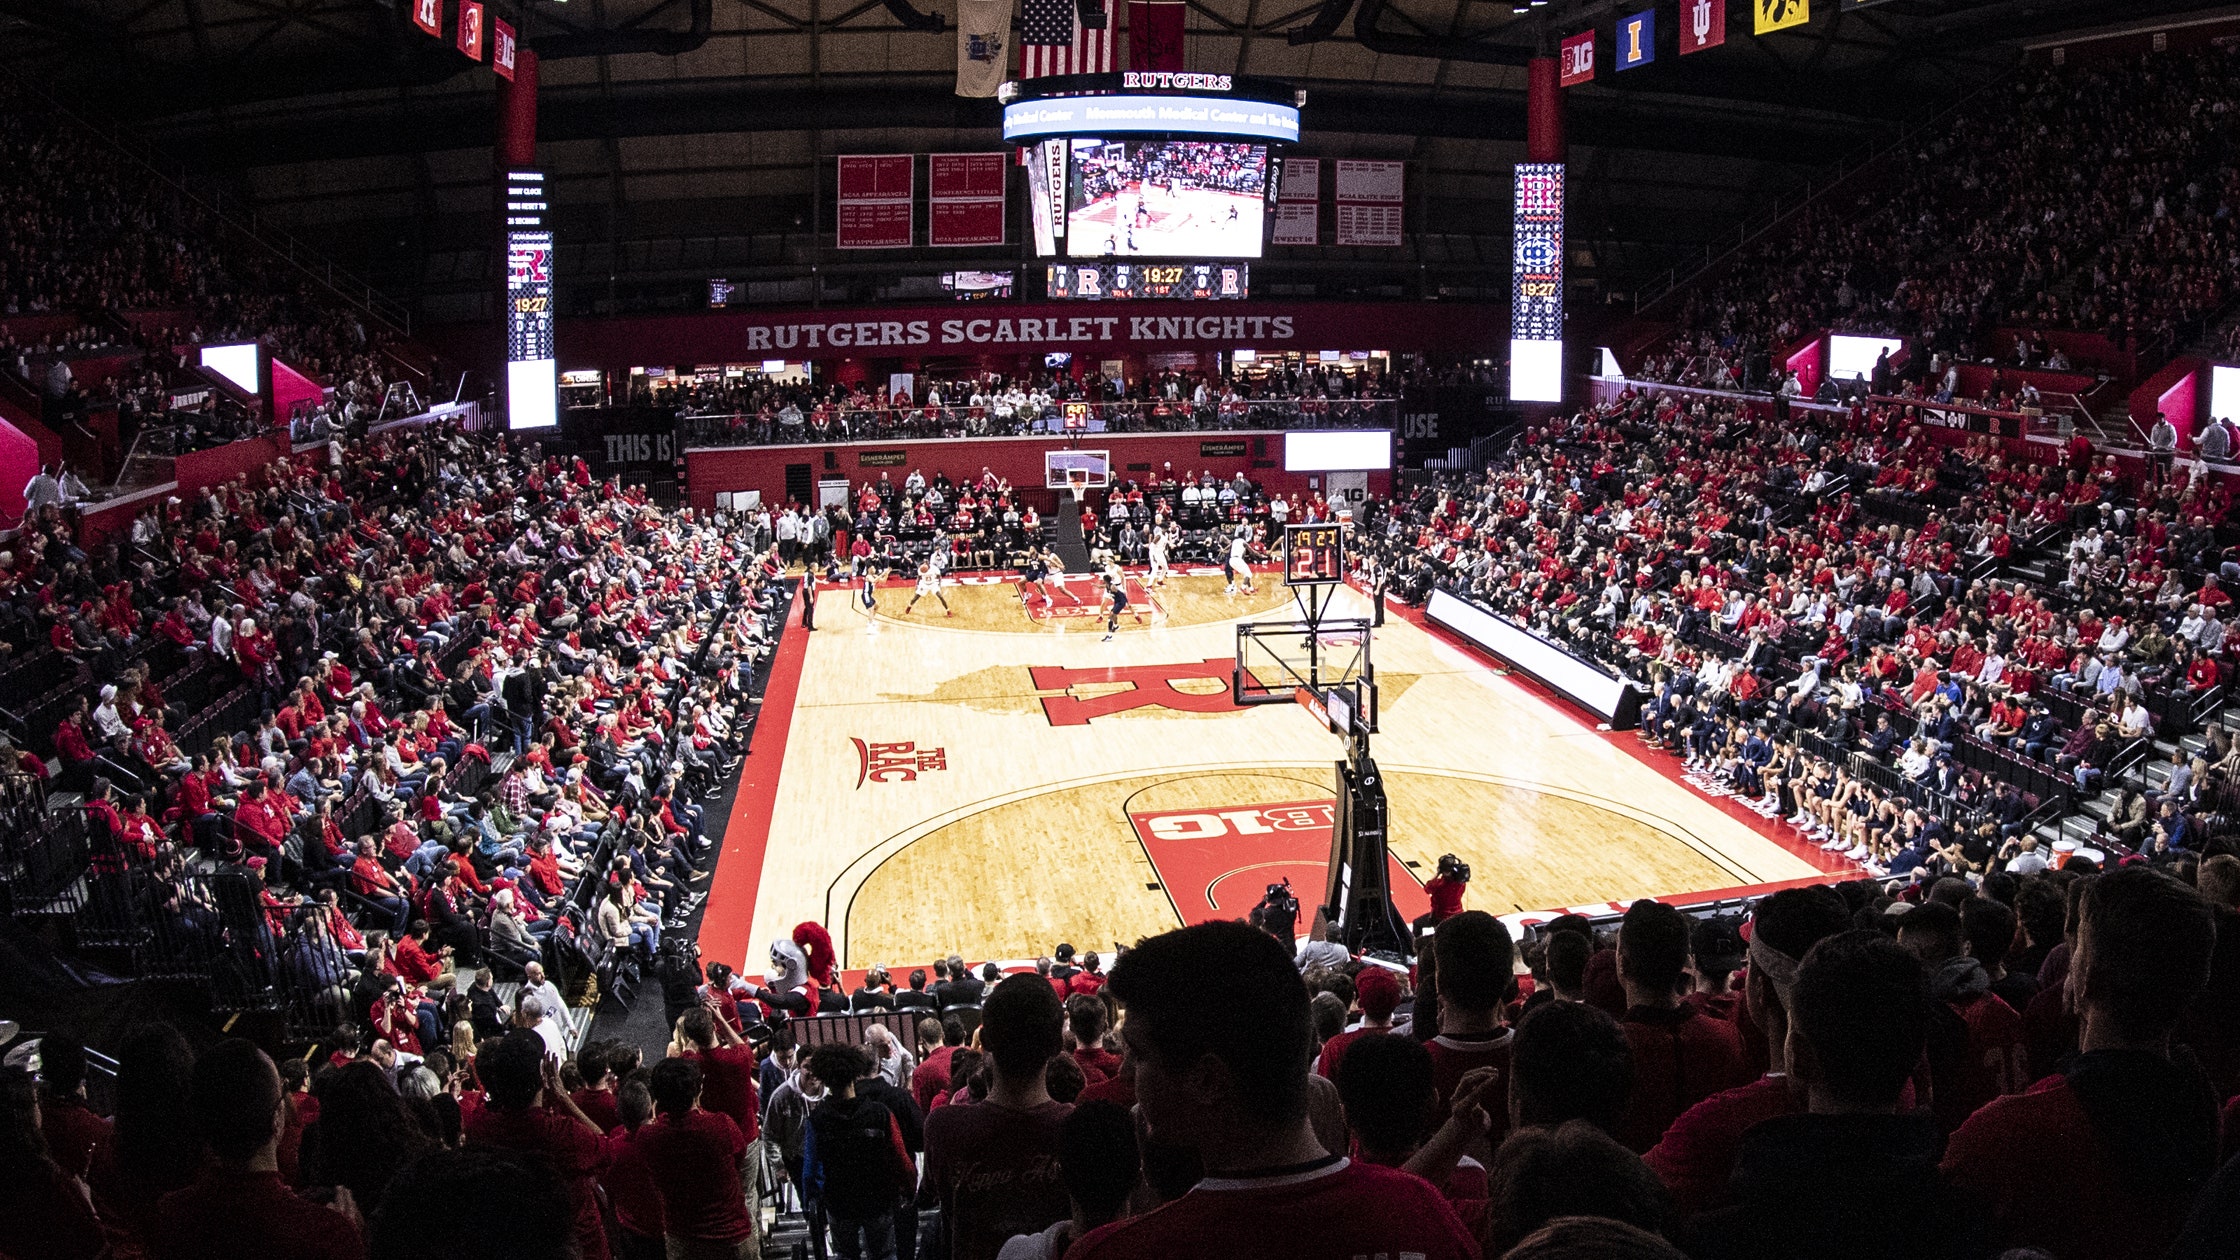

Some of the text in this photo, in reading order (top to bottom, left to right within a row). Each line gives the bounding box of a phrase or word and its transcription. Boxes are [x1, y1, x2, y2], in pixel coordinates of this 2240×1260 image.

[1123, 72, 1232, 90] RUTGERS
[1086, 106, 1156, 121] Monmouth
[1159, 106, 1209, 121] Medical
[1210, 108, 1248, 123] Center
[1052, 144, 1063, 226] RUTGERS
[1116, 265, 1130, 274] RU
[1143, 268, 1183, 283] 19:27
[1194, 265, 1210, 274] PSU
[1077, 268, 1101, 294] R
[1117, 274, 1127, 289] 0
[1197, 274, 1207, 289] 0
[1221, 269, 1239, 294] R
[1127, 289, 1133, 297] 4
[1155, 286, 1170, 294] 1ST
[1520, 283, 1556, 296] 19:27
[515, 298, 548, 312] 19:27
[1521, 303, 1528, 313] 0
[1545, 303, 1552, 314] 0
[516, 320, 524, 332] 0
[538, 319, 546, 331] 0
[747, 316, 1295, 350] RUTGERS SCARLET KNIGHTS
[1067, 414, 1084, 427] 21
[1404, 413, 1439, 439] USE
[1989, 417, 2001, 434] R
[603, 434, 671, 463] THIS IS
[2028, 446, 2044, 458] 113
[1297, 548, 1331, 577] 21
[1028, 657, 1271, 727] R
[869, 741, 947, 782] THE RAC
